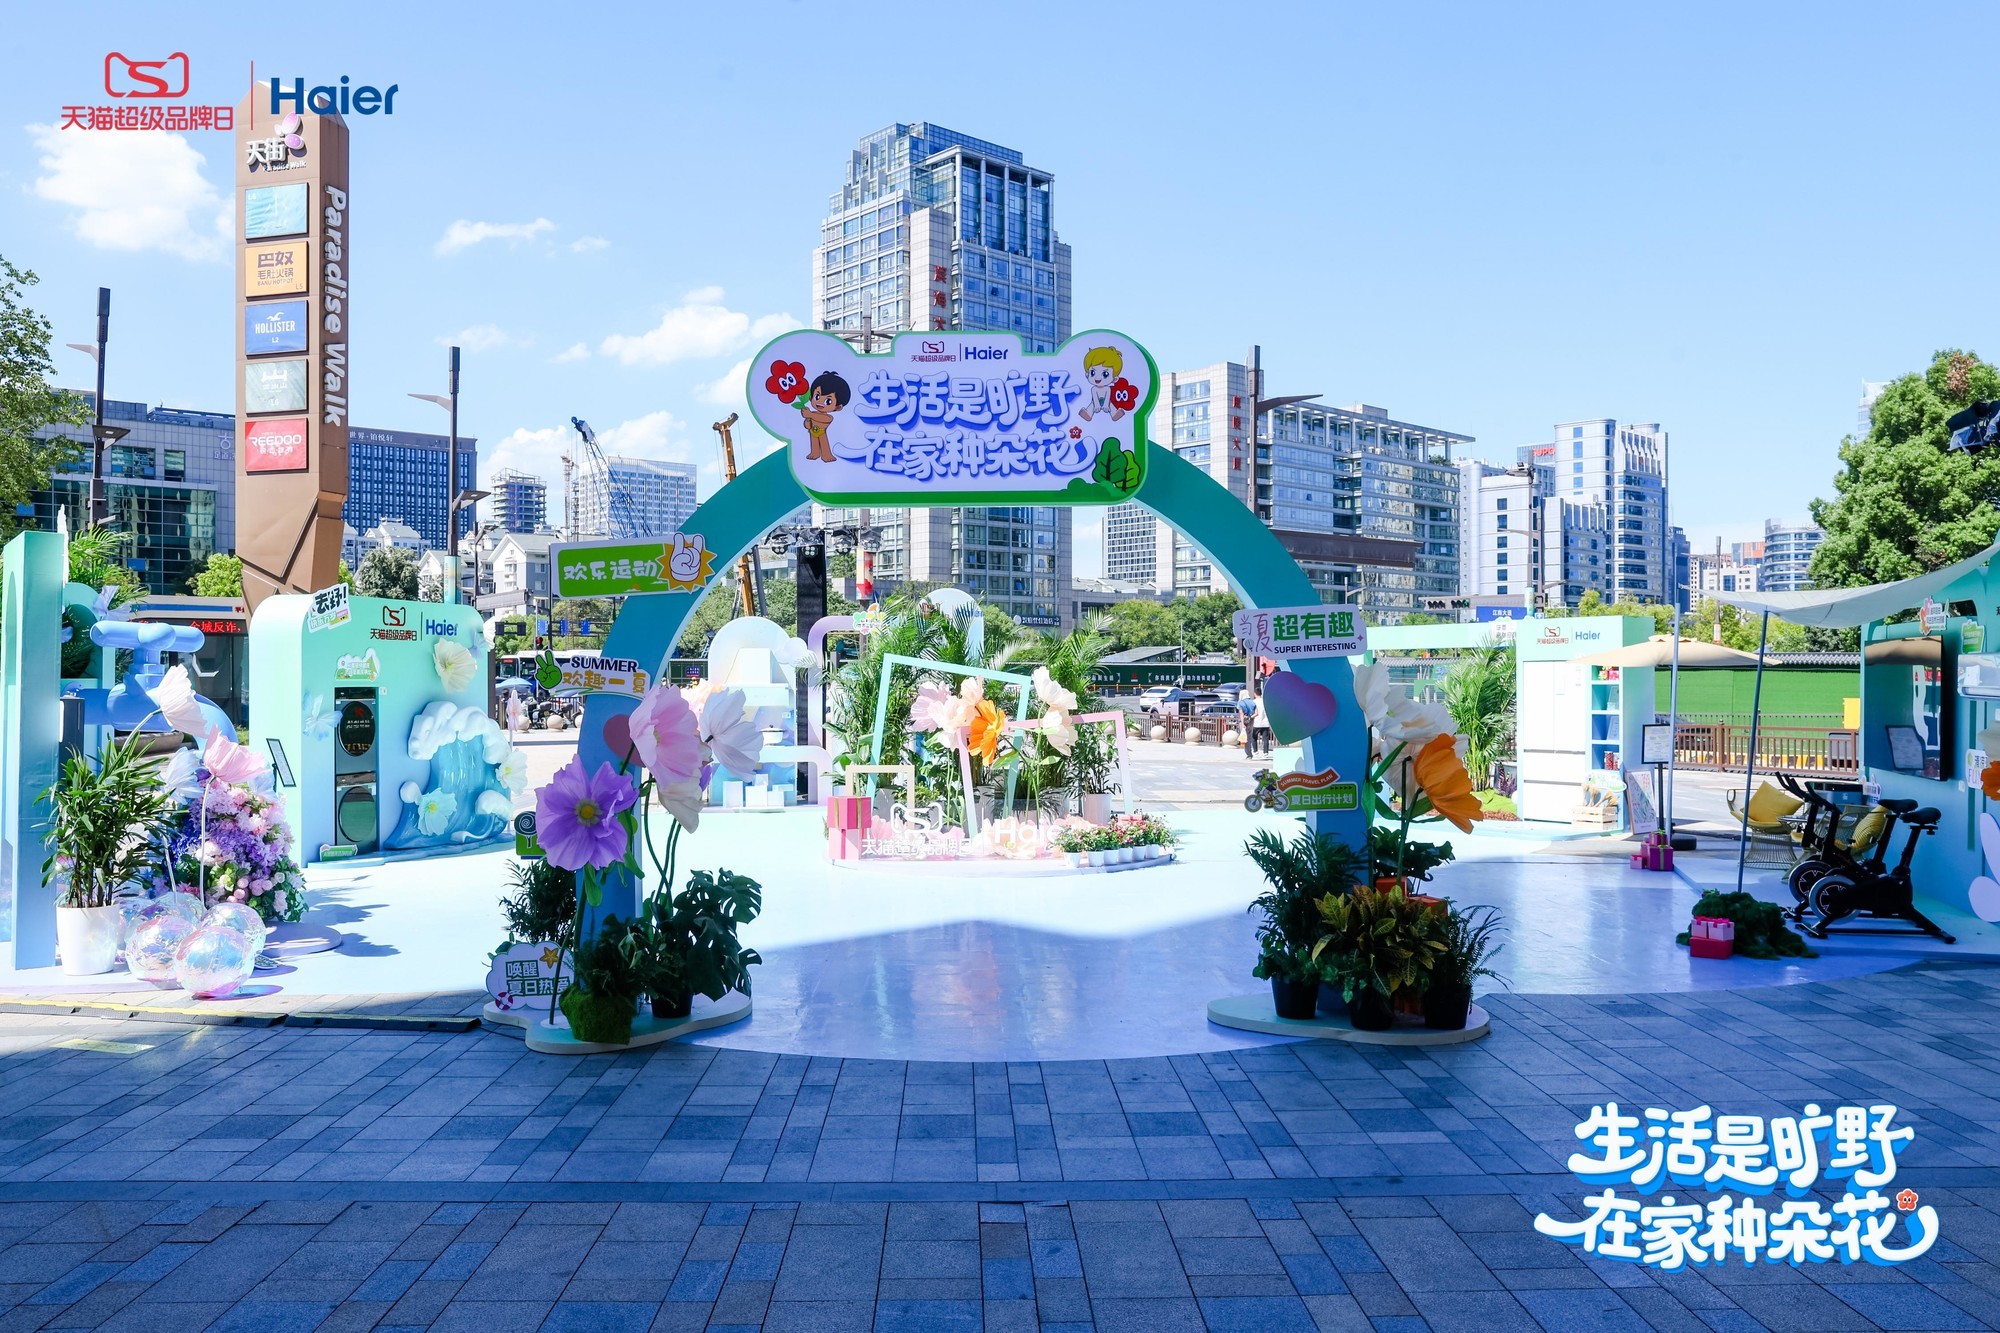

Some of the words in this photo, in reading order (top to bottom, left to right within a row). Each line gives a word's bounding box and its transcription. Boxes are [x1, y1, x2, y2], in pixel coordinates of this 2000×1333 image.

[246, 138, 285, 165] 天街
[257, 251, 294, 268] 巴奴
[324, 184, 347, 334] Paradise
[257, 267, 294, 280] 毛肚火锅
[255, 320, 296, 334] HOLLISTER
[911, 354, 956, 362] 天猫超级品牌日
[964, 346, 1009, 360] Haier
[324, 343, 346, 427] Walk
[855, 368, 1081, 427] 生活是旷野
[248, 434, 302, 446] REEDOO
[833, 426, 1100, 481] 在家种朵花
[563, 559, 657, 581] 欢乐运动
[370, 628, 417, 641] 天猫超级品牌日
[426, 619, 458, 636] Haier
[1273, 611, 1355, 642] 超有趣
[1575, 631, 1601, 641] Haier
[1274, 646, 1302, 654] SUPER
[1303, 642, 1357, 653] INTERESTING
[571, 656, 638, 673] SUMMER
[562, 669, 647, 694] 欢趣一夏
[1280, 777, 1302, 787] SUMMER
[1320, 774, 1334, 783] PLAN
[1291, 793, 1353, 806] 夏日出行计划
[994, 819, 1064, 845] Haie
[861, 838, 972, 856] 天猫超级品牌日
[507, 961, 538, 977] 唤醒
[508, 977, 569, 996] 夏日热爱
